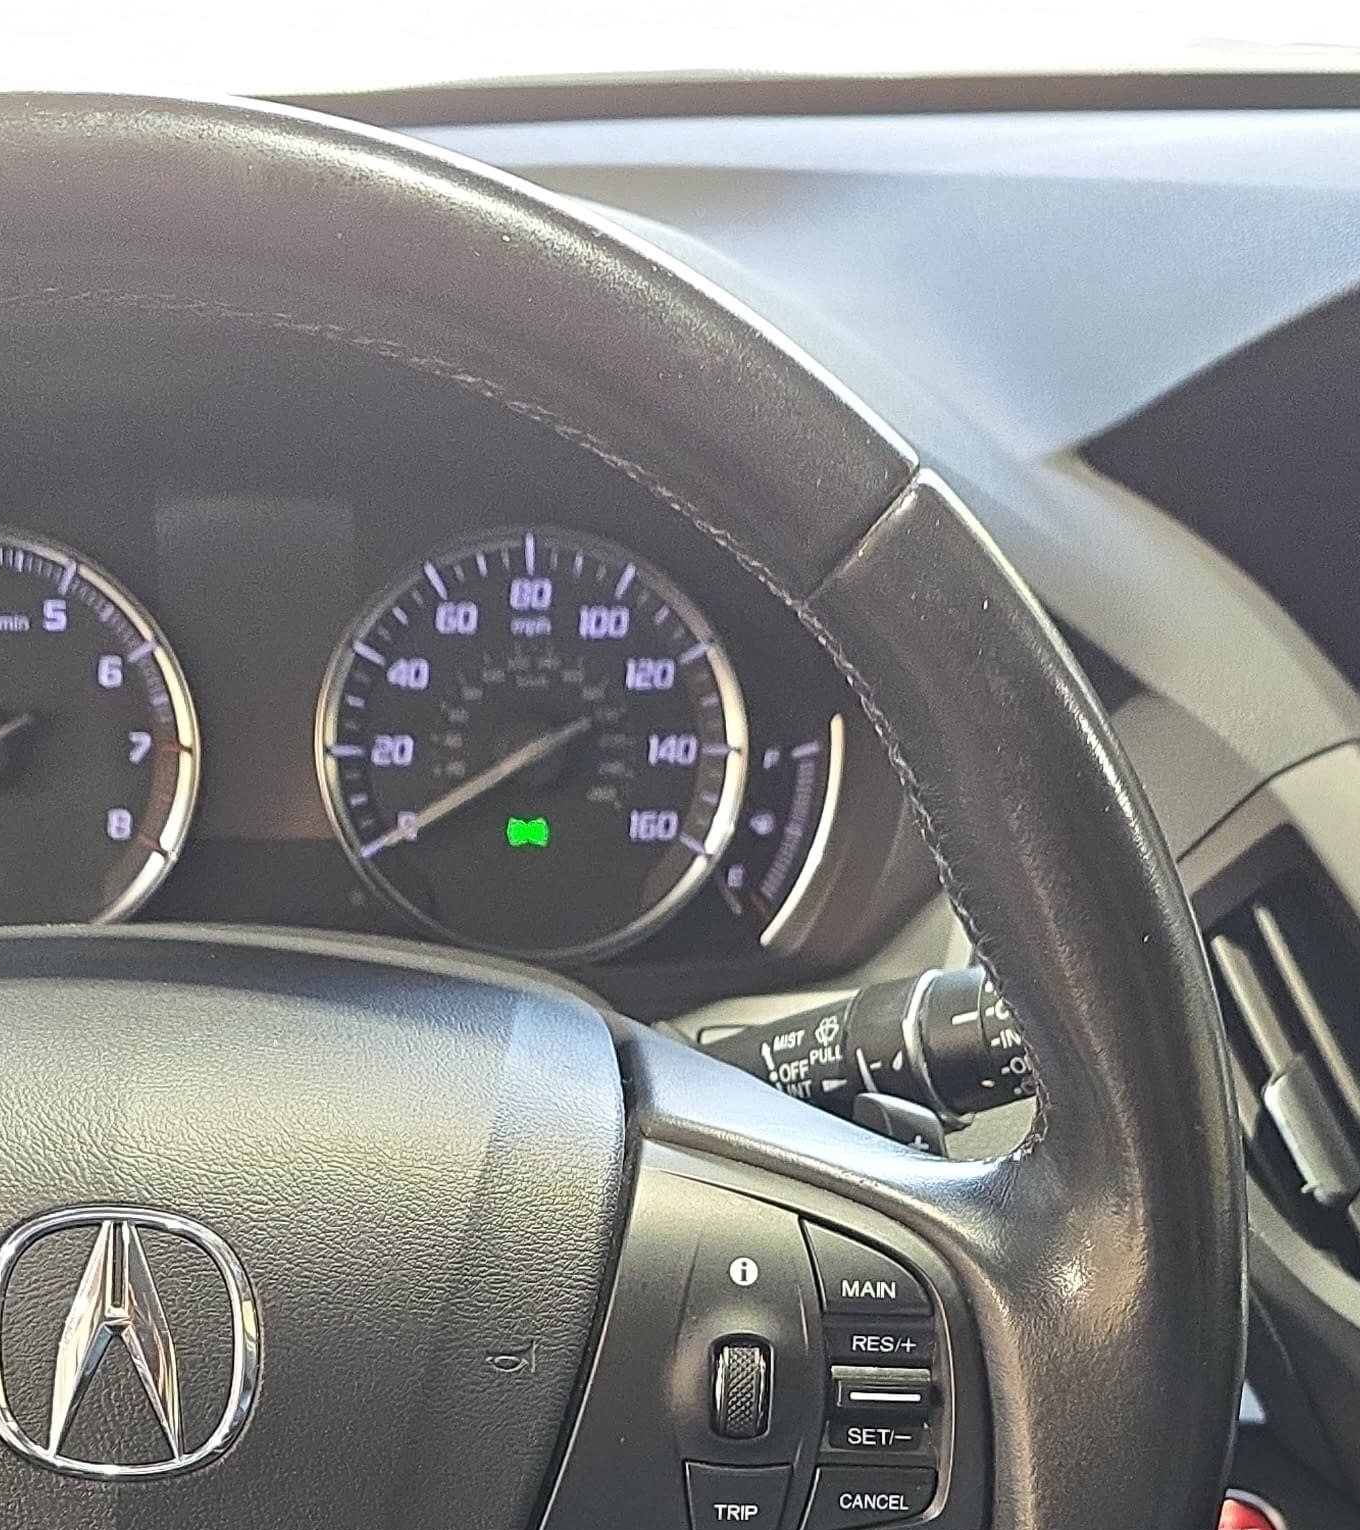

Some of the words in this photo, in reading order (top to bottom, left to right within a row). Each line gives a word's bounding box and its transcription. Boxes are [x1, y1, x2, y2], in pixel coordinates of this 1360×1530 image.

[509, 577, 552, 610] 80
[43, 600, 67, 631] 5
[435, 601, 478, 635] 60
[510, 617, 551, 637] mph
[578, 607, 629, 639] 100
[97, 655, 123, 688] 6
[387, 658, 430, 690] 40
[625, 658, 675, 690] 120
[128, 730, 151, 764] 7
[371, 734, 414, 765] 20
[647, 734, 697, 765] 140
[107, 808, 132, 841] 8
[629, 810, 678, 842] 160
[773, 1029, 805, 1052] MIST
[809, 1044, 843, 1065] PULL
[1000, 1029, 1021, 1049] IN
[779, 1059, 809, 1082] OFF
[841, 1280, 897, 1300] MAIN
[714, 1504, 759, 1521] TRIP
[839, 1493, 909, 1511] CANCEL
